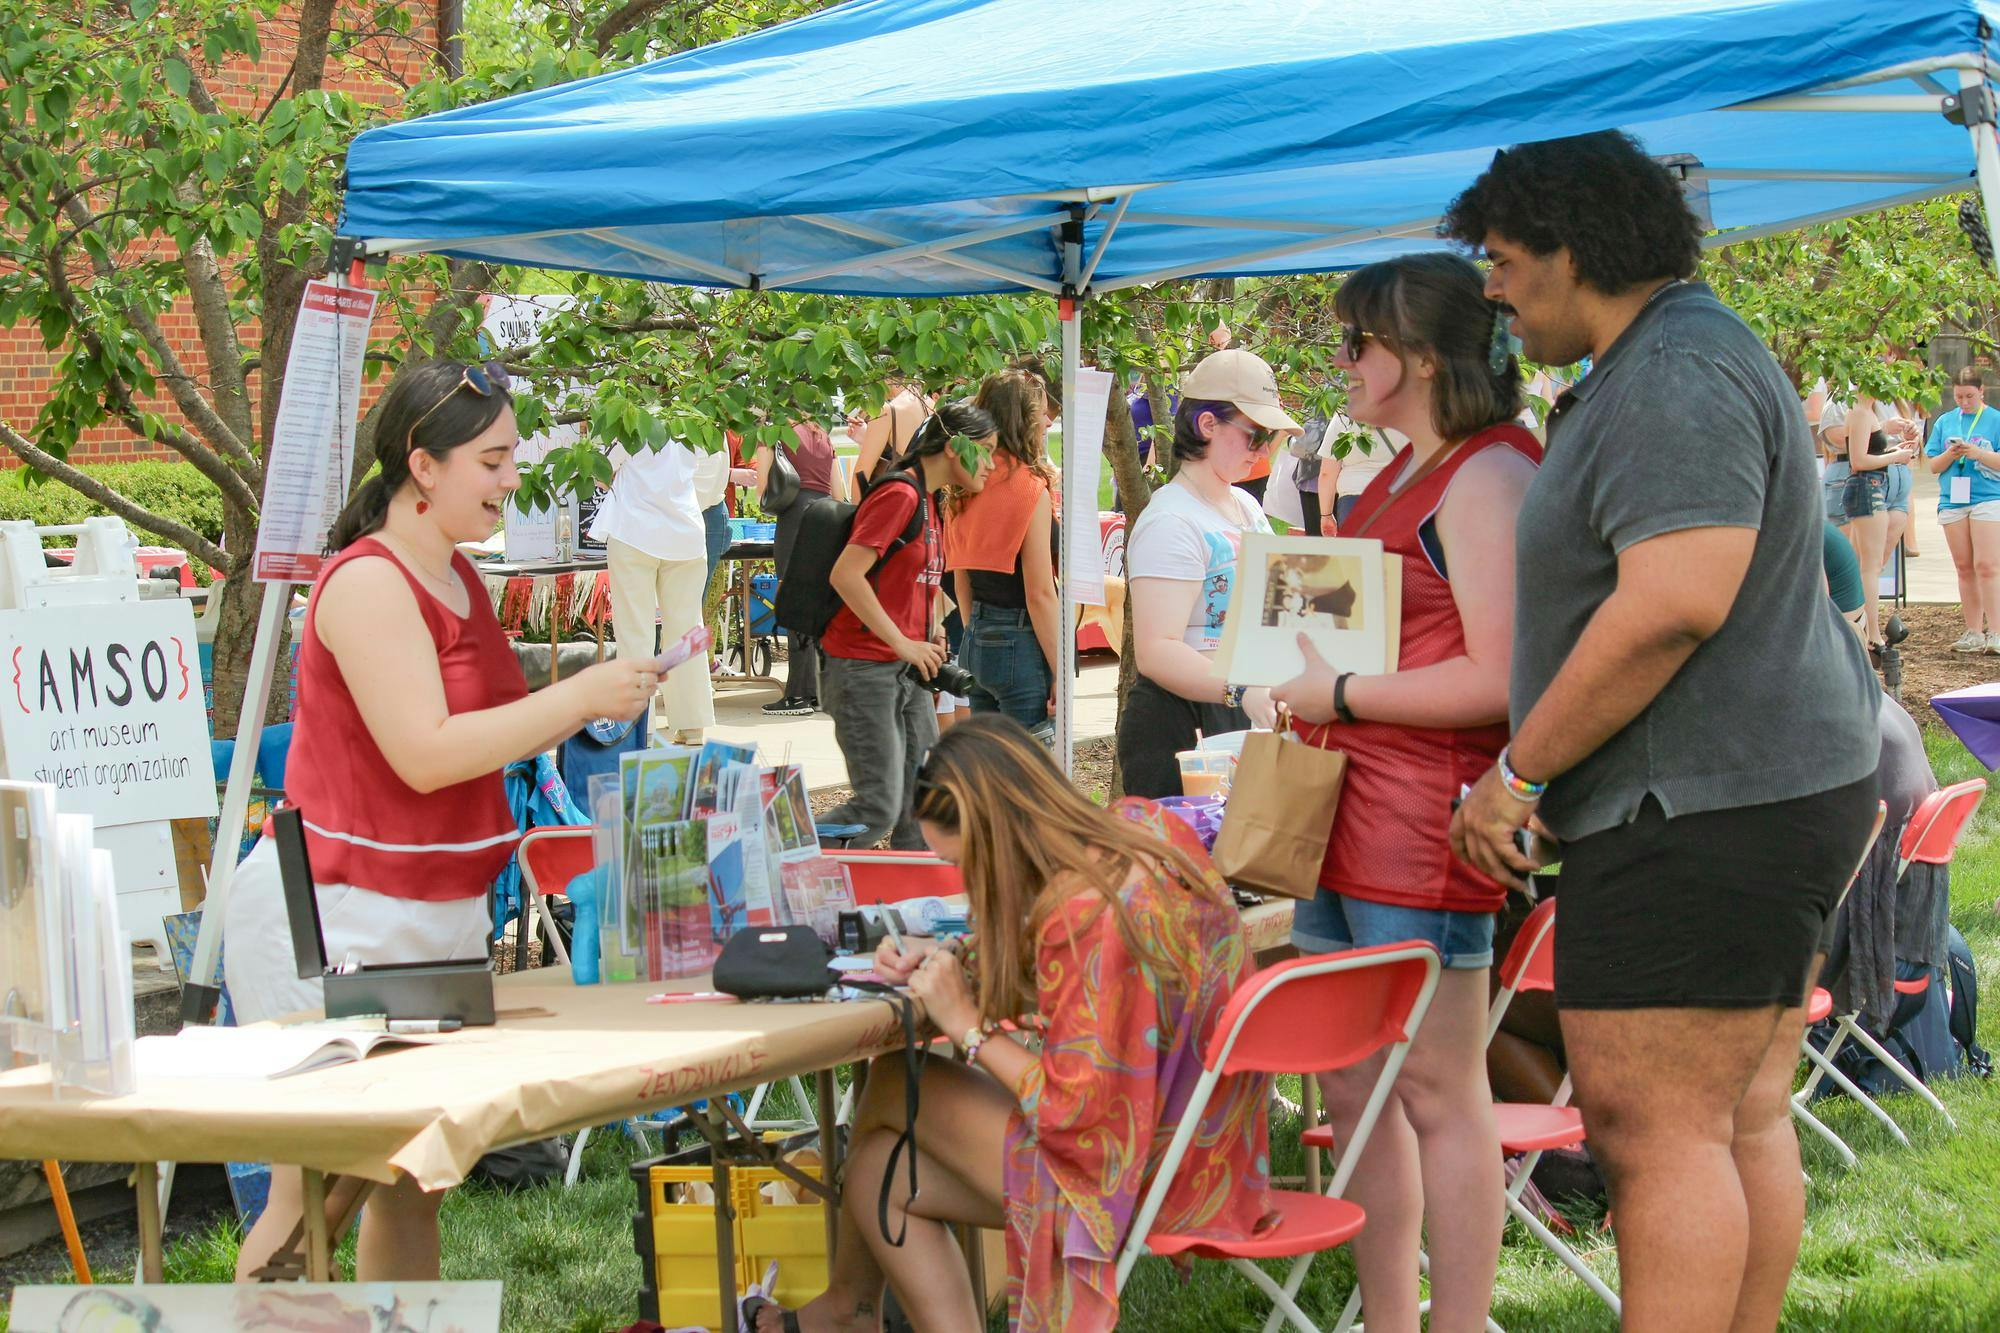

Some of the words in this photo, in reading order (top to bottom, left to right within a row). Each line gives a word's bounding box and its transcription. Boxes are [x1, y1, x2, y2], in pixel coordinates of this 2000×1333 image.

[323, 294, 337, 306] THE
[500, 320, 530, 338] SWING
[51, 724, 75, 752] art
[83, 721, 159, 748] museum
[34, 760, 89, 790] student
[94, 754, 190, 795] organization
